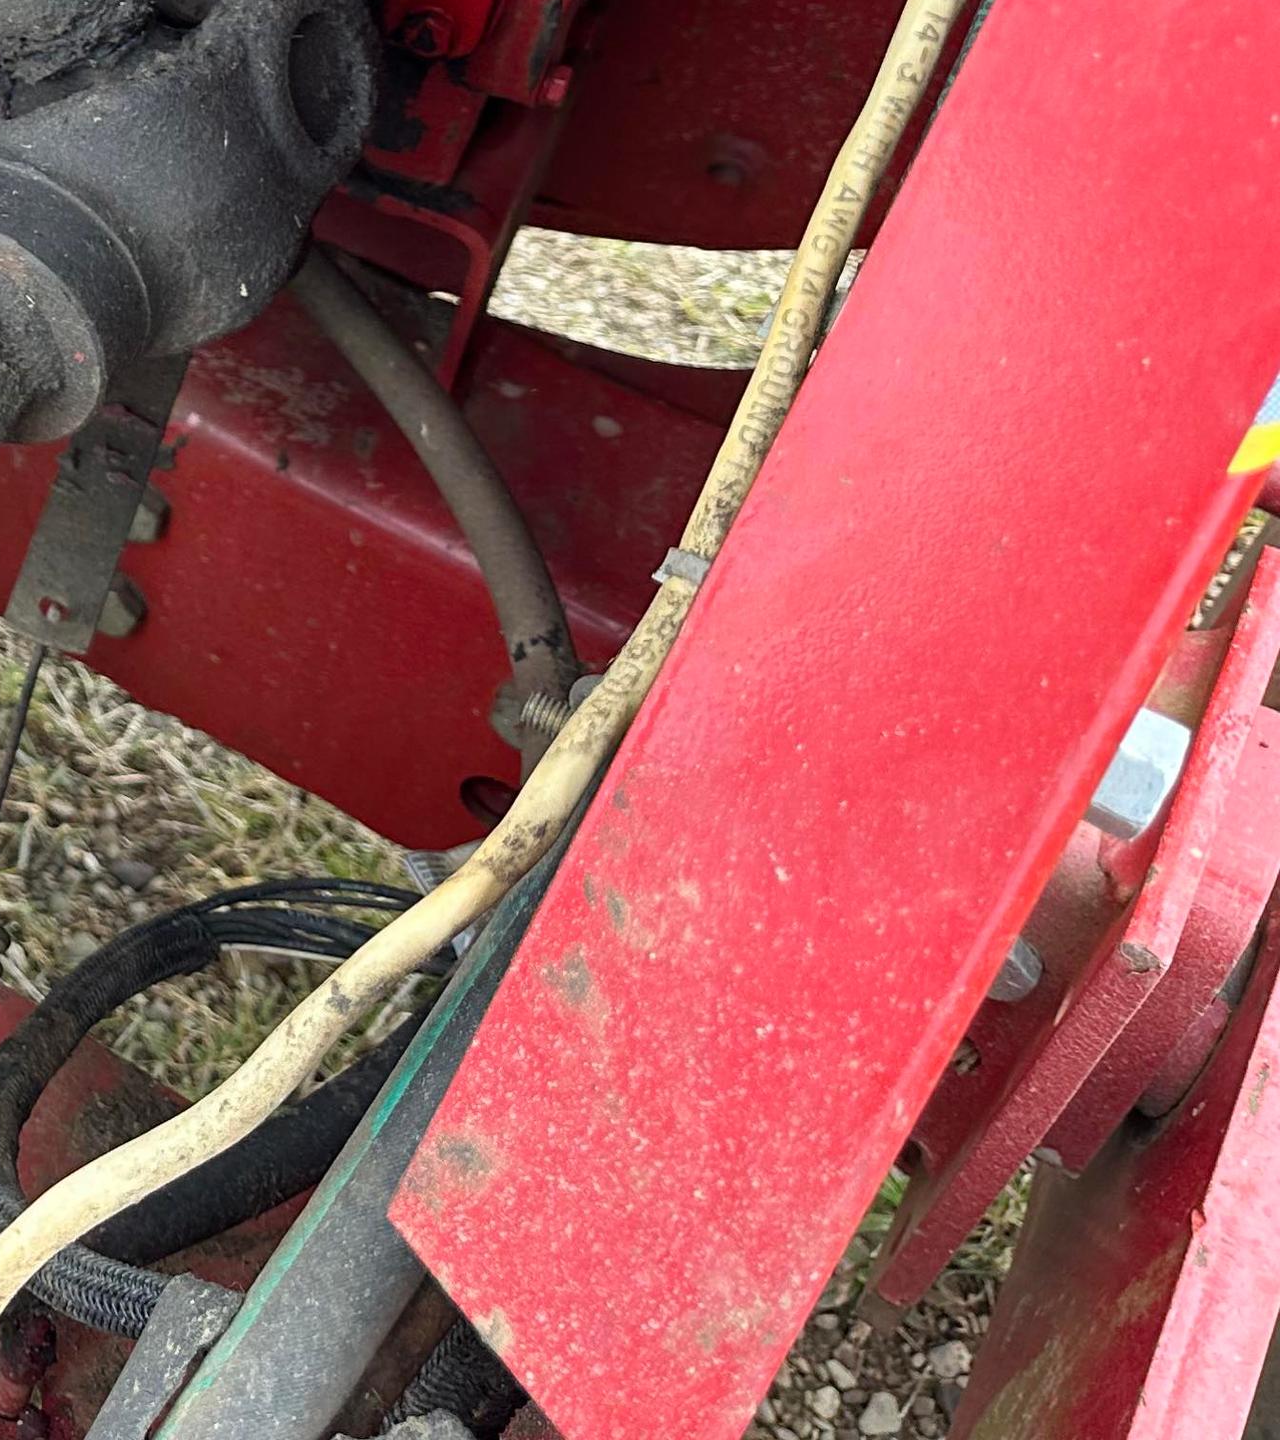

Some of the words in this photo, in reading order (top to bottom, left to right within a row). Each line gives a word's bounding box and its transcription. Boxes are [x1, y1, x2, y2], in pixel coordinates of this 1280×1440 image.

[895, 10, 948, 86] 14-3
[852, 94, 910, 174] WITH
[810, 182, 863, 258] AWG
[798, 266, 826, 297] 14
[738, 306, 810, 451] GROUND
